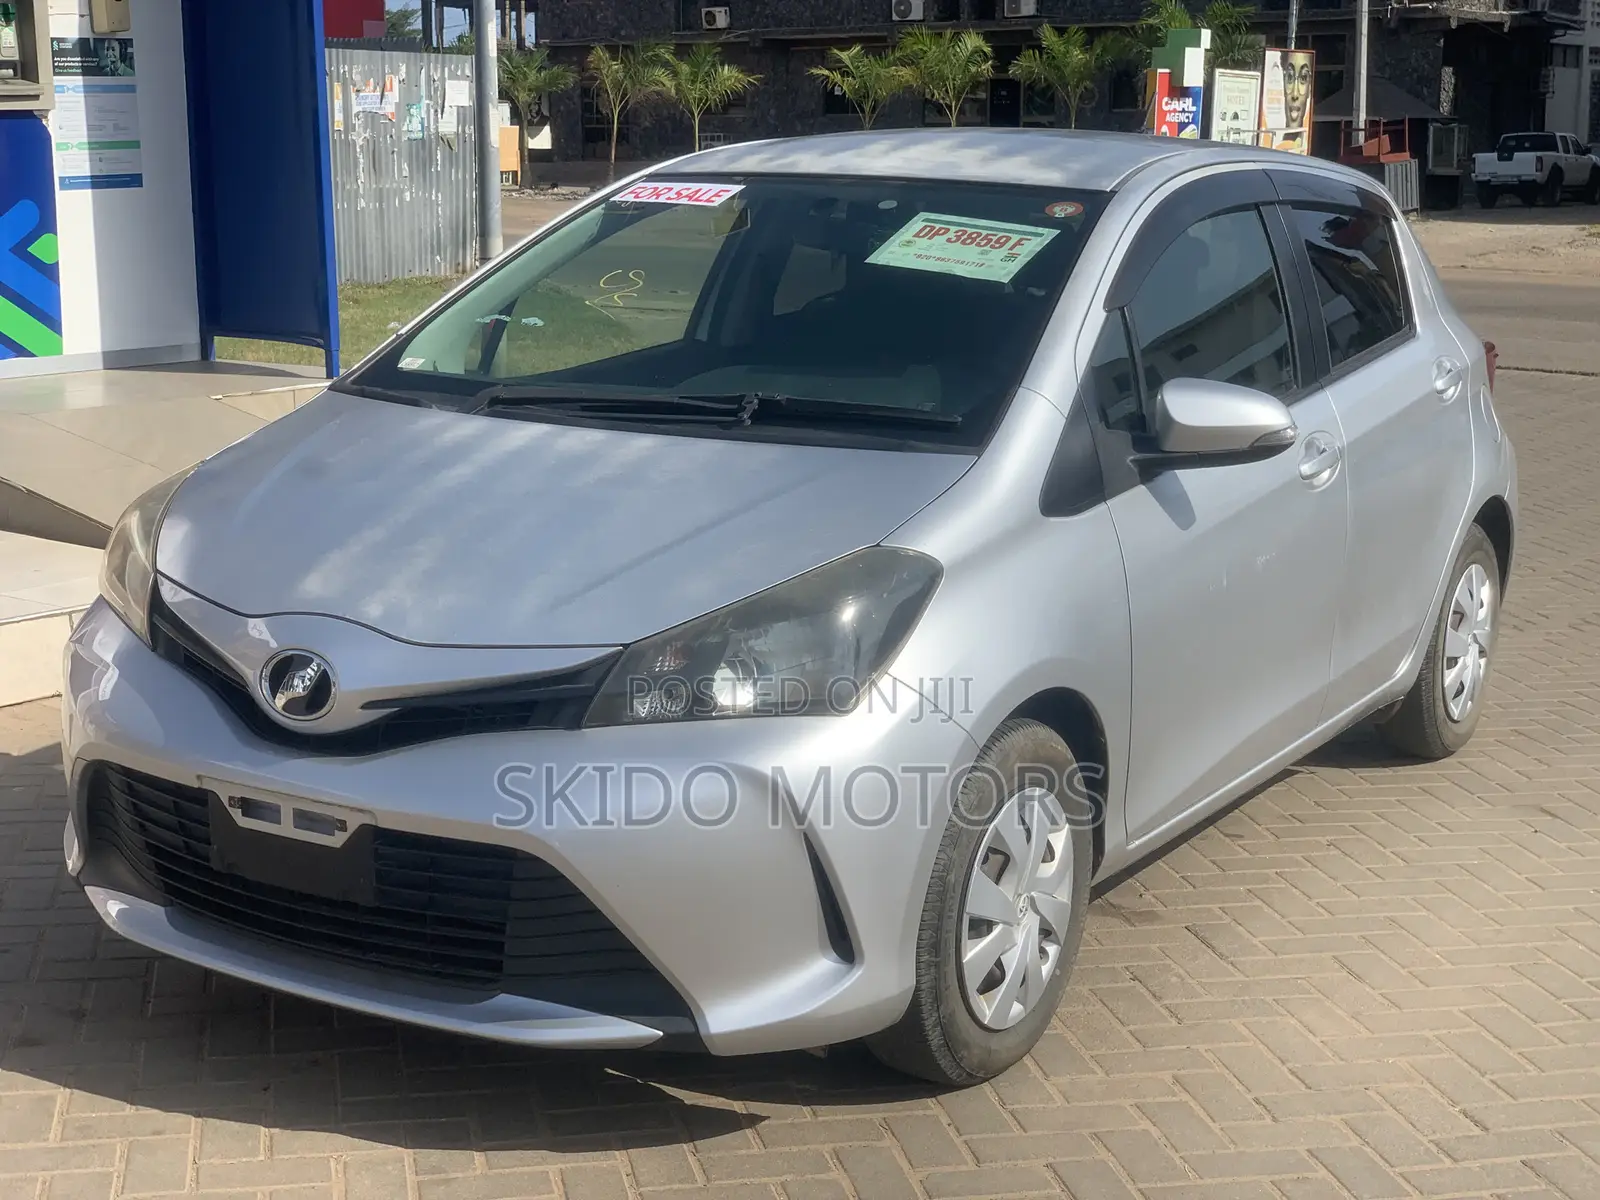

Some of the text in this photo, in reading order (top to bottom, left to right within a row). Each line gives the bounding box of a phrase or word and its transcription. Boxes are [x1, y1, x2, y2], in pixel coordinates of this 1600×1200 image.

[1162, 96, 1197, 112] CARL
[1165, 112, 1194, 123] AGENCY
[620, 186, 732, 203] FOR SALE
[912, 224, 951, 241] DP
[946, 229, 1012, 250] 3859
[1008, 237, 1032, 251] F
